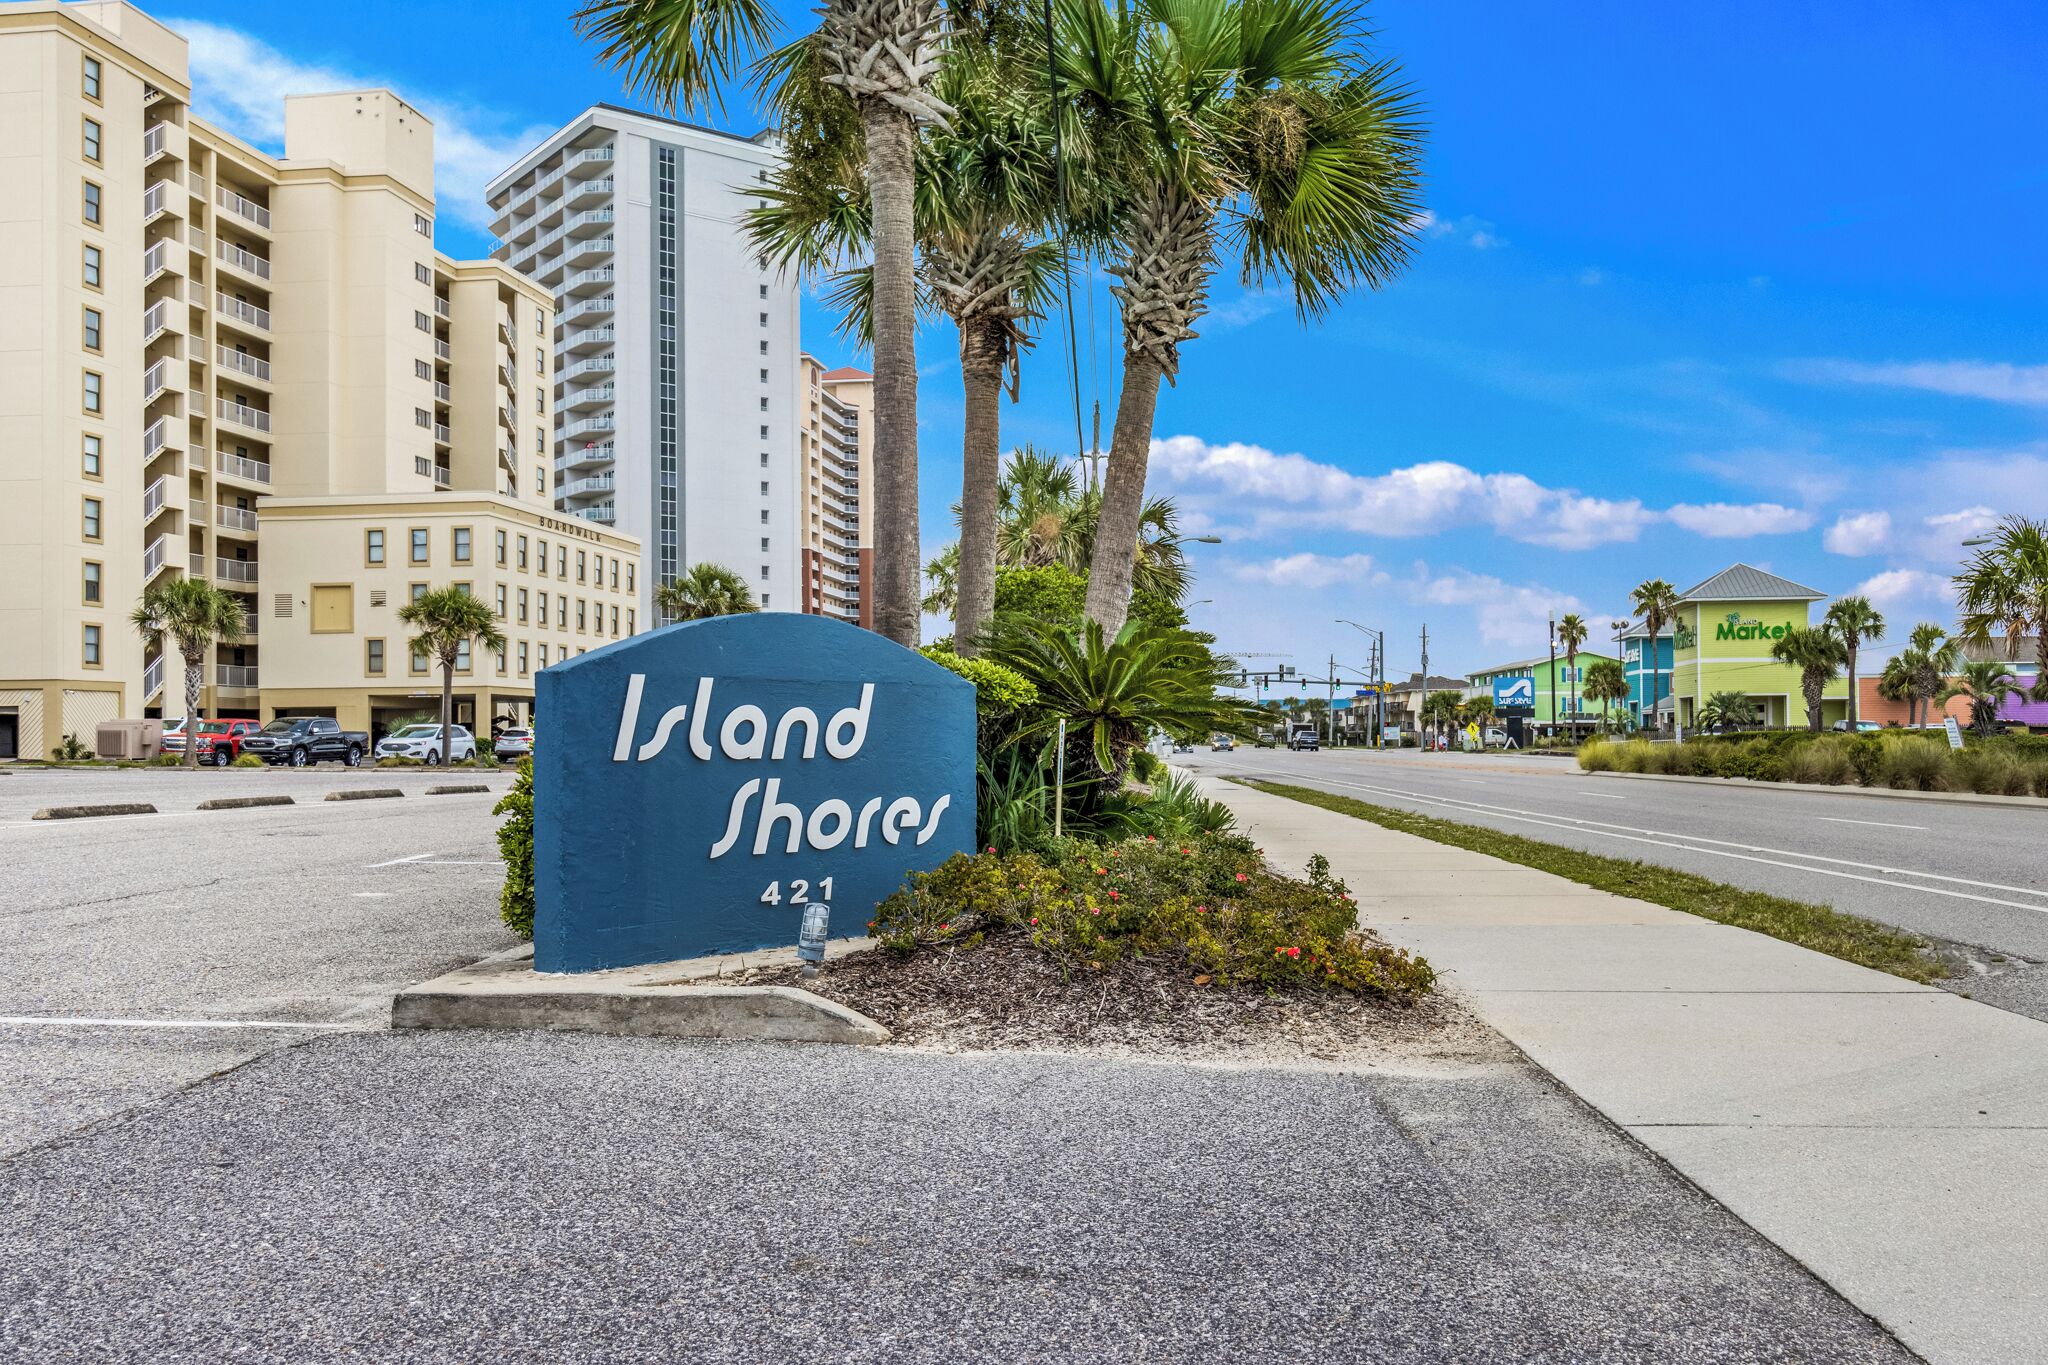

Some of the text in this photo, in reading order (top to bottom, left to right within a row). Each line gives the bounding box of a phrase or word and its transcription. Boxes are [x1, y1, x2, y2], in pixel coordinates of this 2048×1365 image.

[540, 516, 601, 542] BOARDWALK
[1716, 621, 1792, 641] Market
[613, 673, 875, 762] Island
[710, 777, 951, 860] Shores
[760, 876, 833, 906] 421
